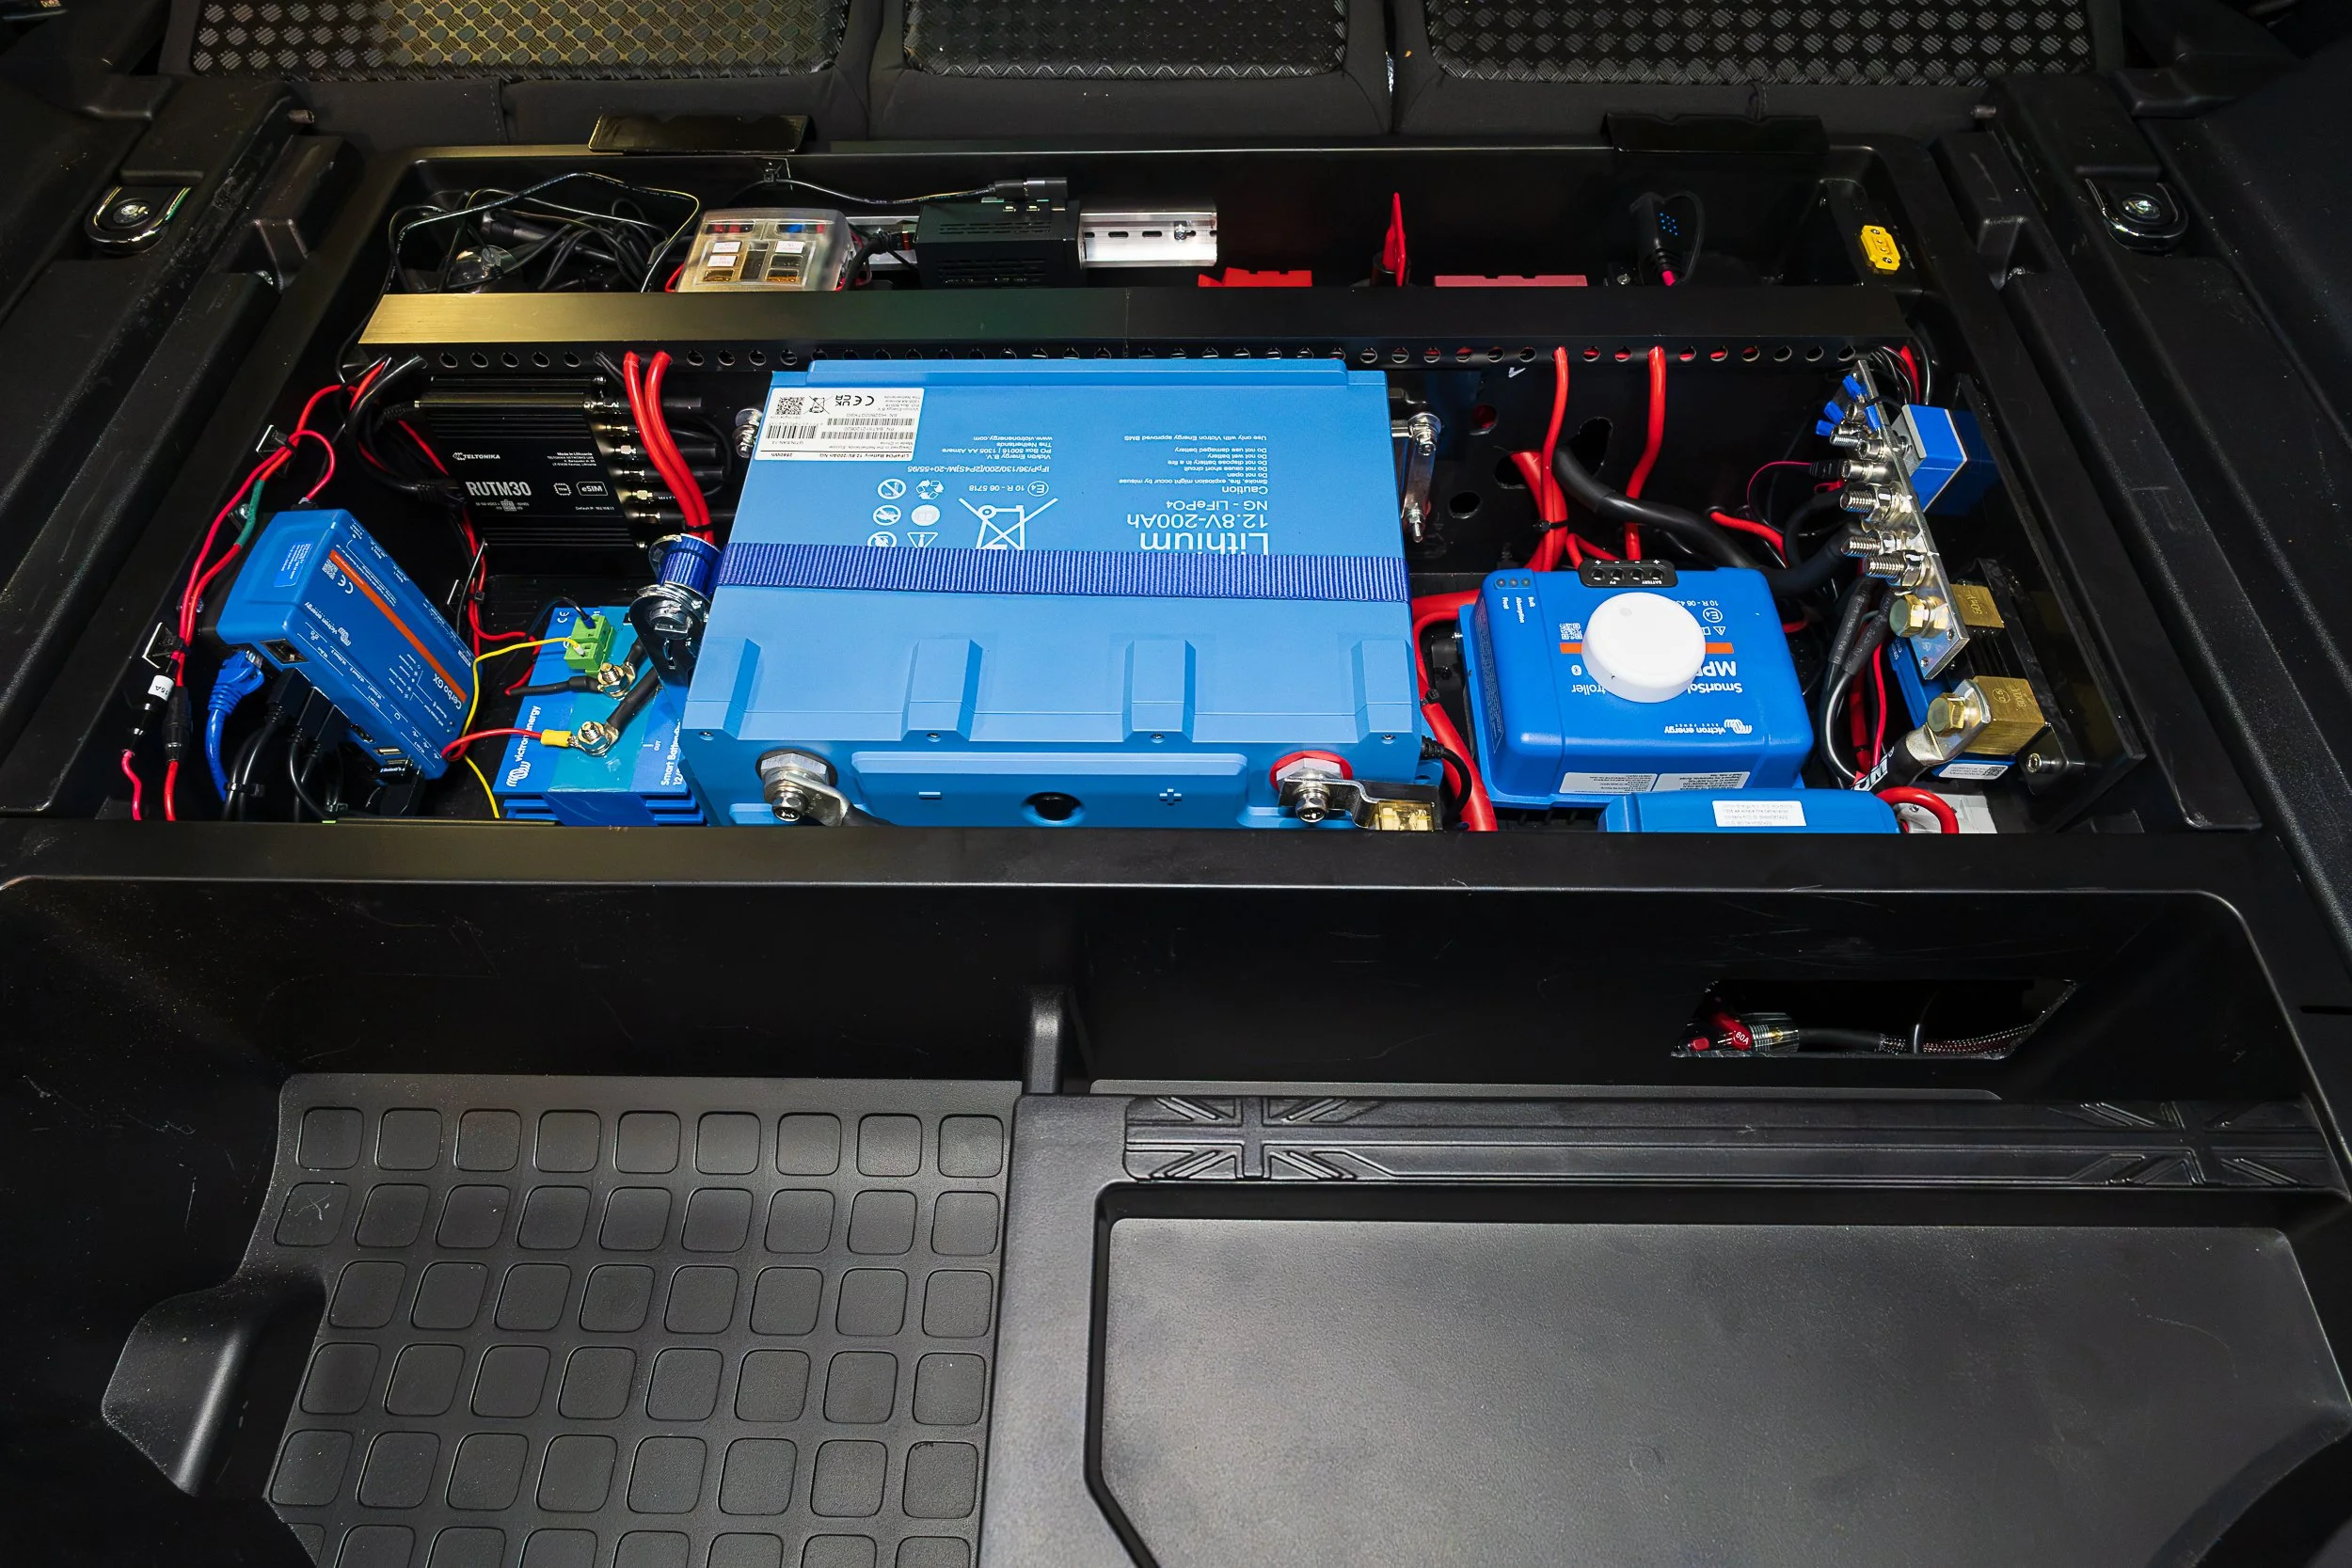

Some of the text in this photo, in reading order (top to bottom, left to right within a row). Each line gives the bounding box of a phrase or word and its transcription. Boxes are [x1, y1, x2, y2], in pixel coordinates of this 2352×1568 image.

[466, 482, 532, 497] RUTM30
[1221, 485, 1268, 494] Caution
[1244, 500, 1267, 511] NG
[1126, 514, 1268, 529] 12.8V-200Ah
[1516, 596, 1524, 623] Absorption
[433, 673, 463, 709] Cerbo GX
[660, 761, 675, 785] Smart
[1736, 1031, 1749, 1045] 60A
